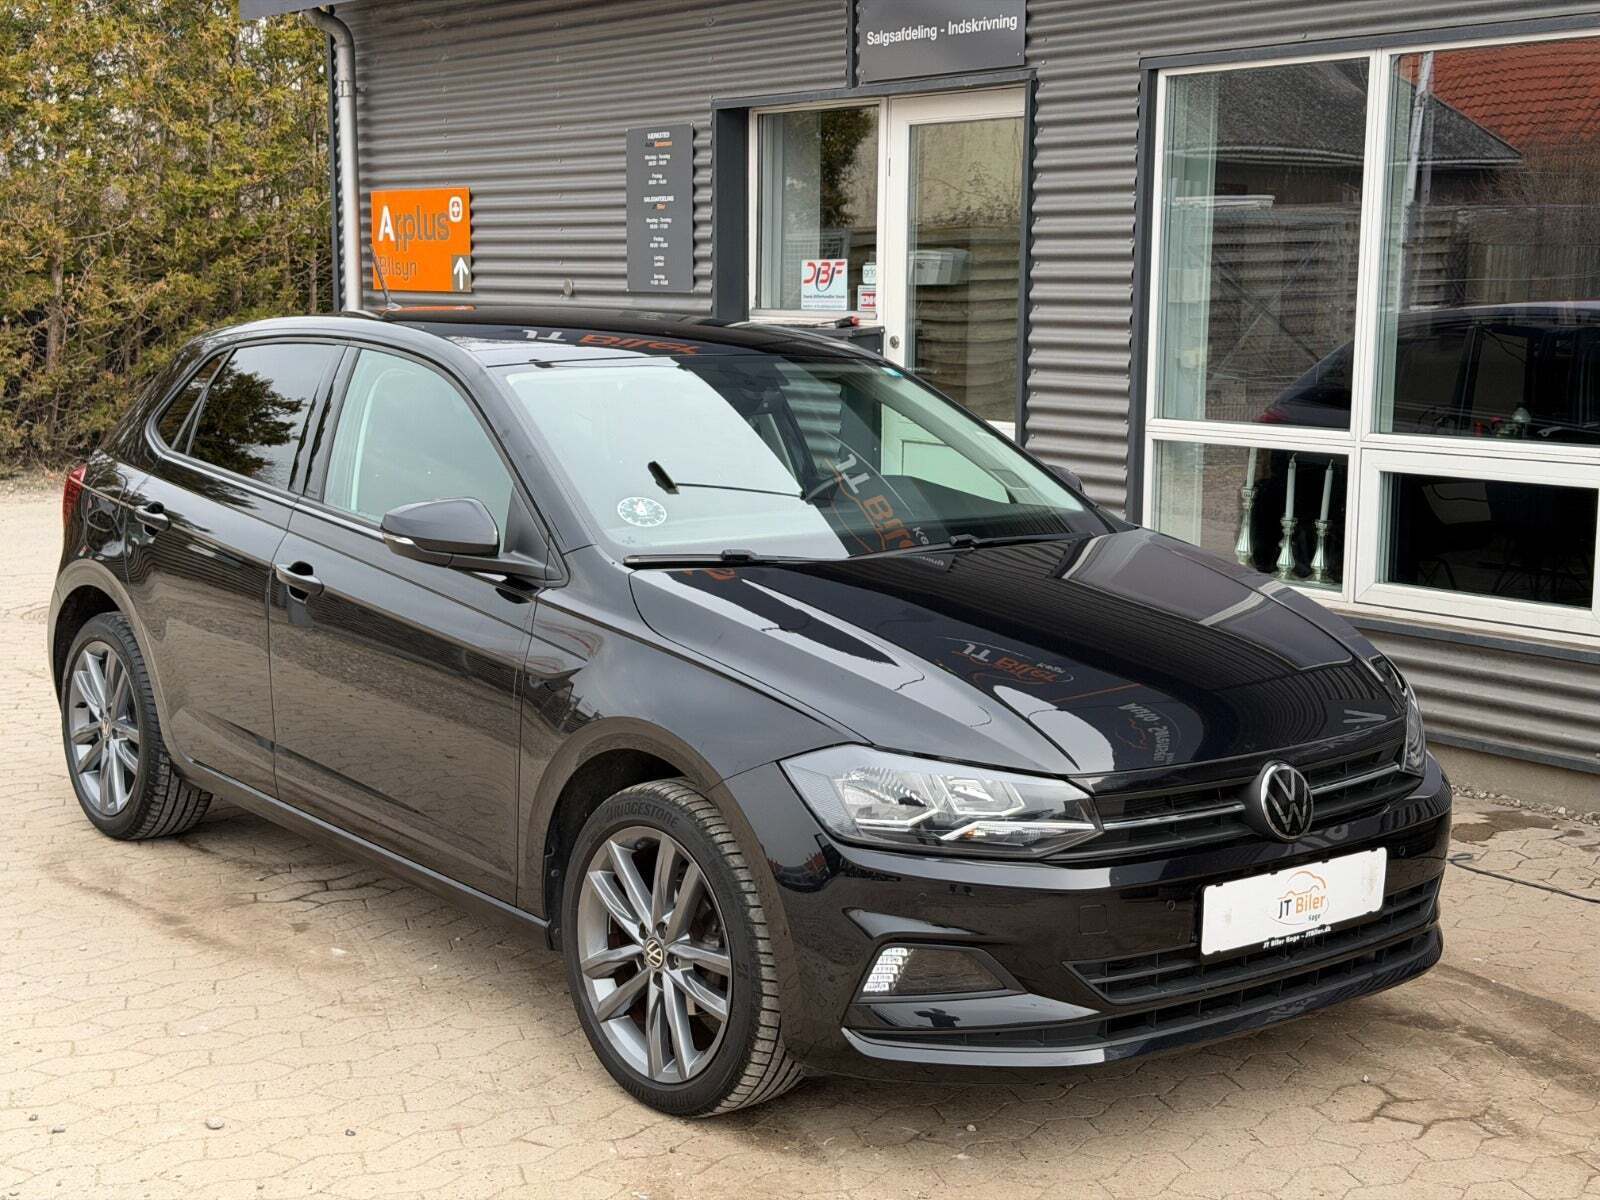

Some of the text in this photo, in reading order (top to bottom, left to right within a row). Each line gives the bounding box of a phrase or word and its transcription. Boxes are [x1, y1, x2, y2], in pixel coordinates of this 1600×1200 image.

[867, 24, 937, 46] Salgsafdeling
[948, 14, 1018, 36] Indskrivning
[1295, 894, 1326, 914] Biler
